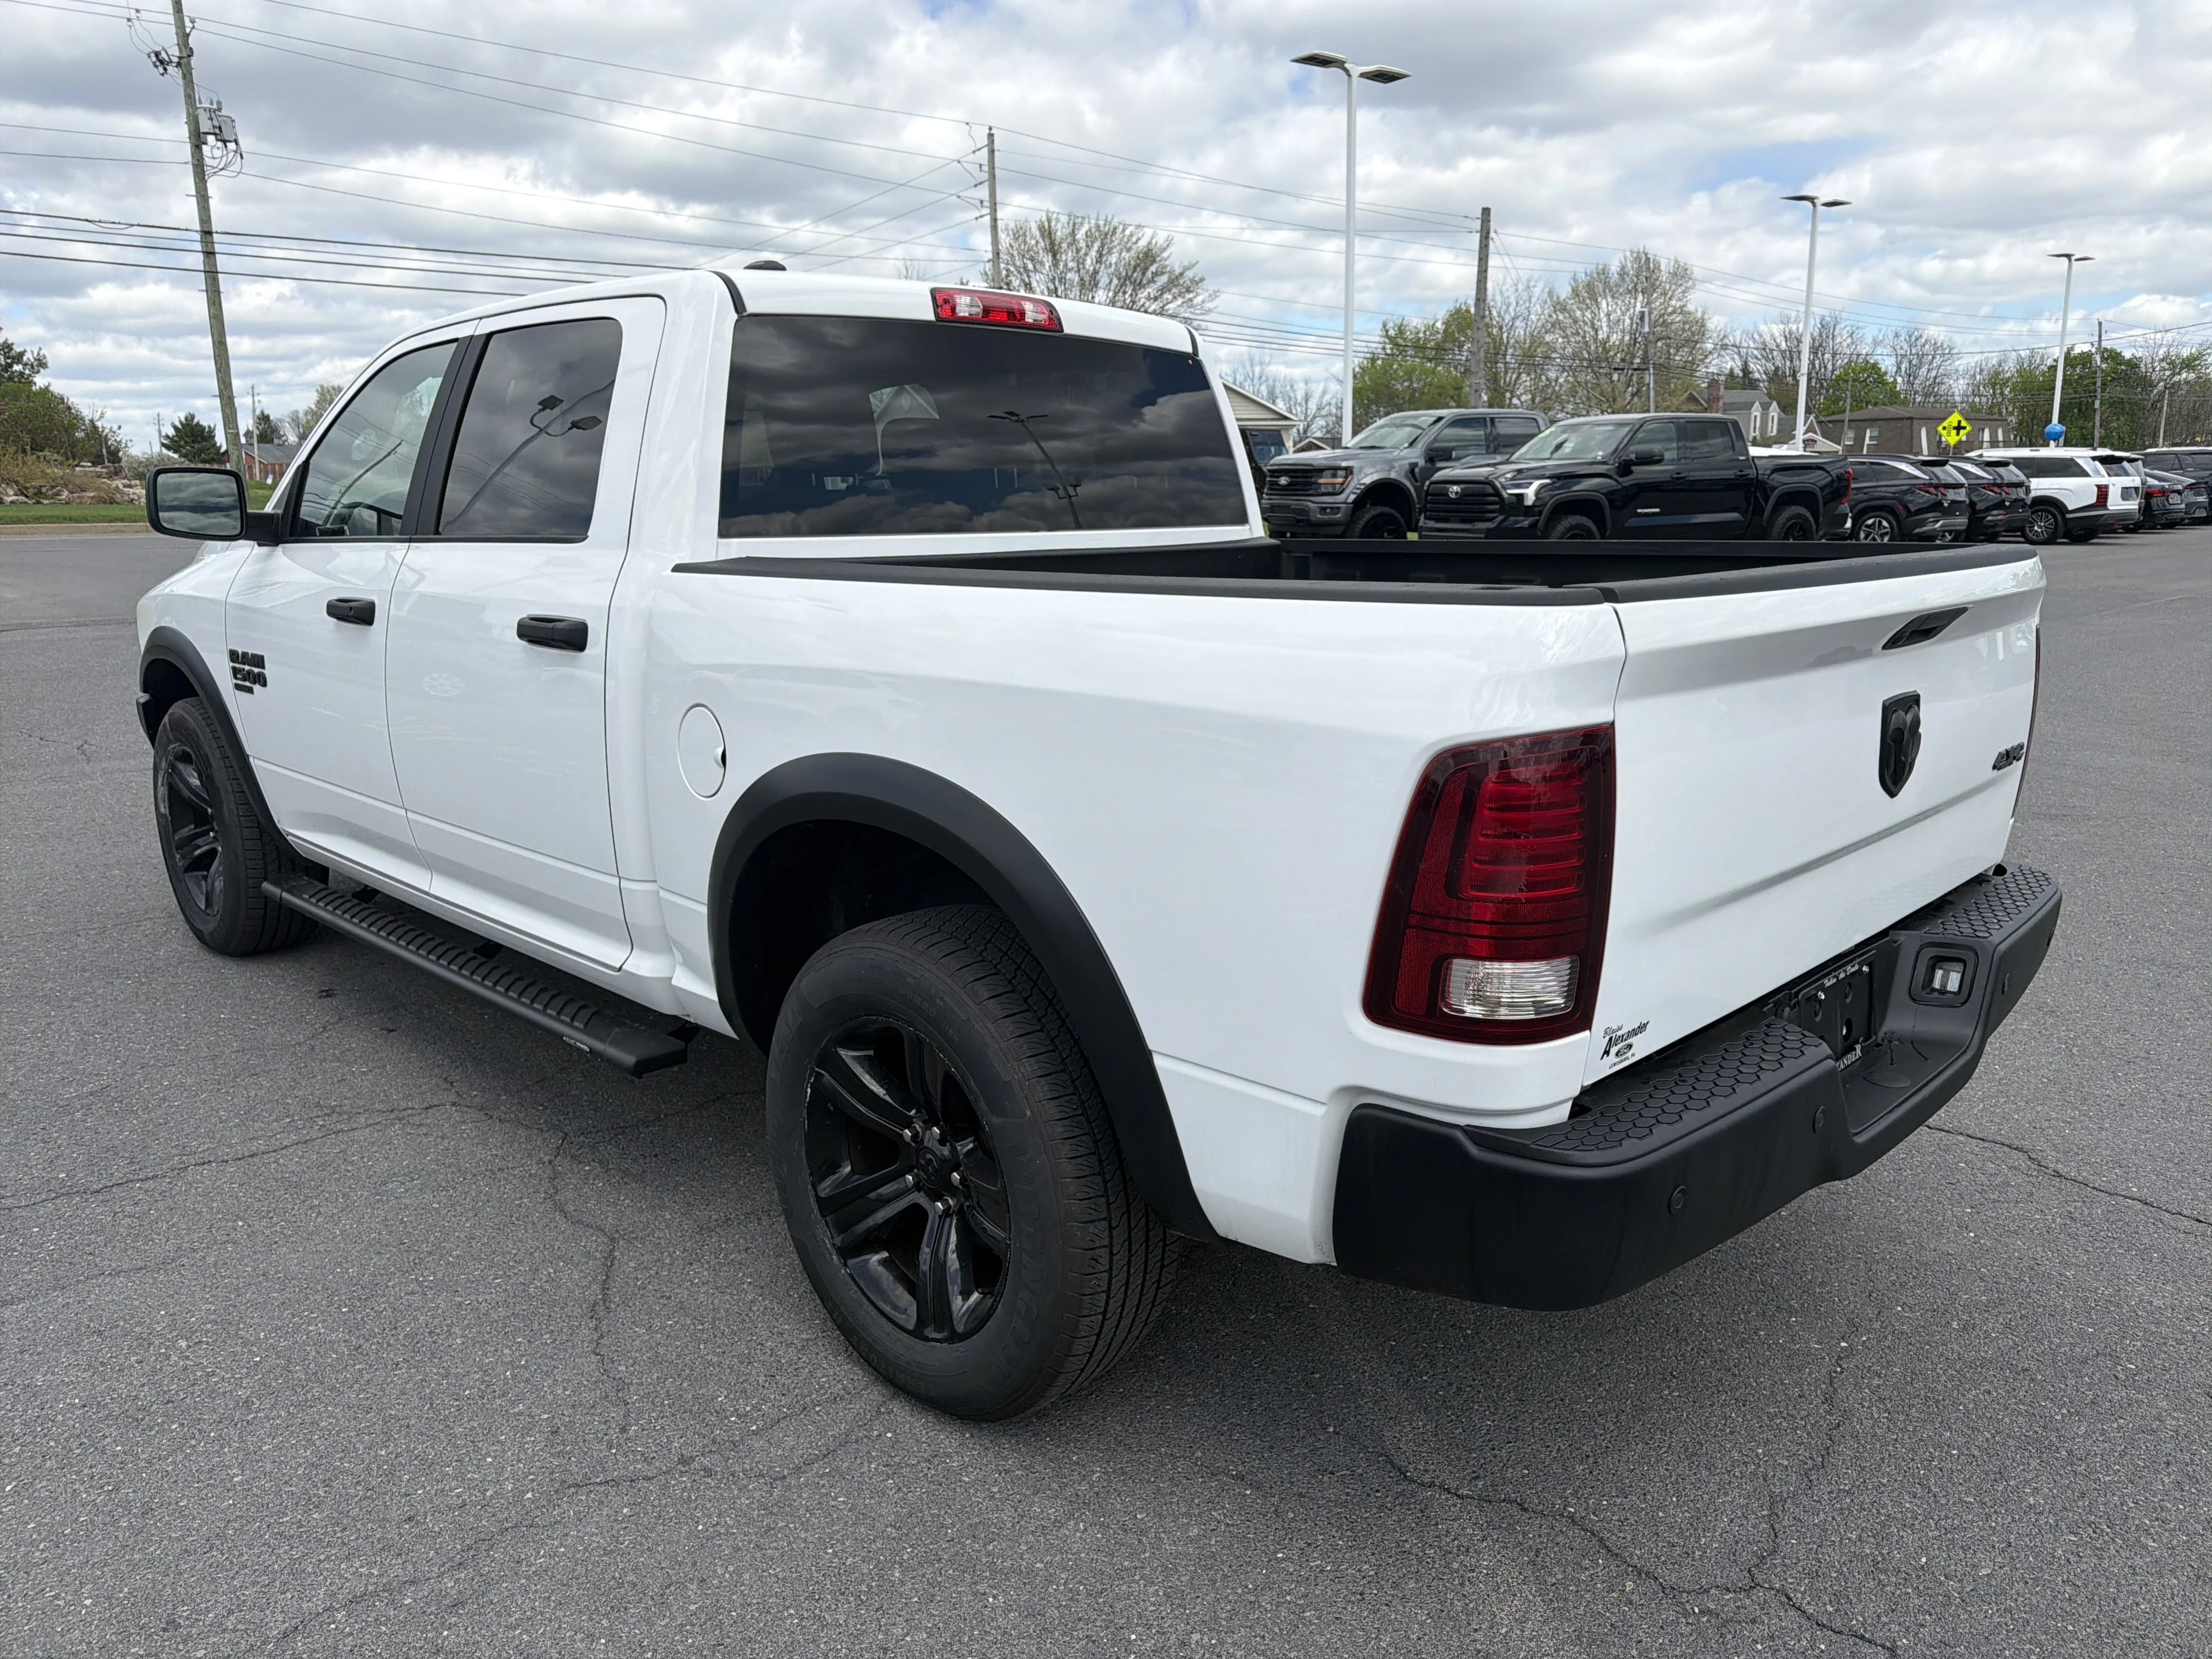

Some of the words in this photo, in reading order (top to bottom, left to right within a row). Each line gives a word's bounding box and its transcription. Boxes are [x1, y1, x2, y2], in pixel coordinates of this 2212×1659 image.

[229, 648, 266, 670] RAM
[231, 665, 268, 688] 1500
[1600, 1020, 1650, 1061] Alexander
[1602, 1024, 1623, 1039] Blaise
